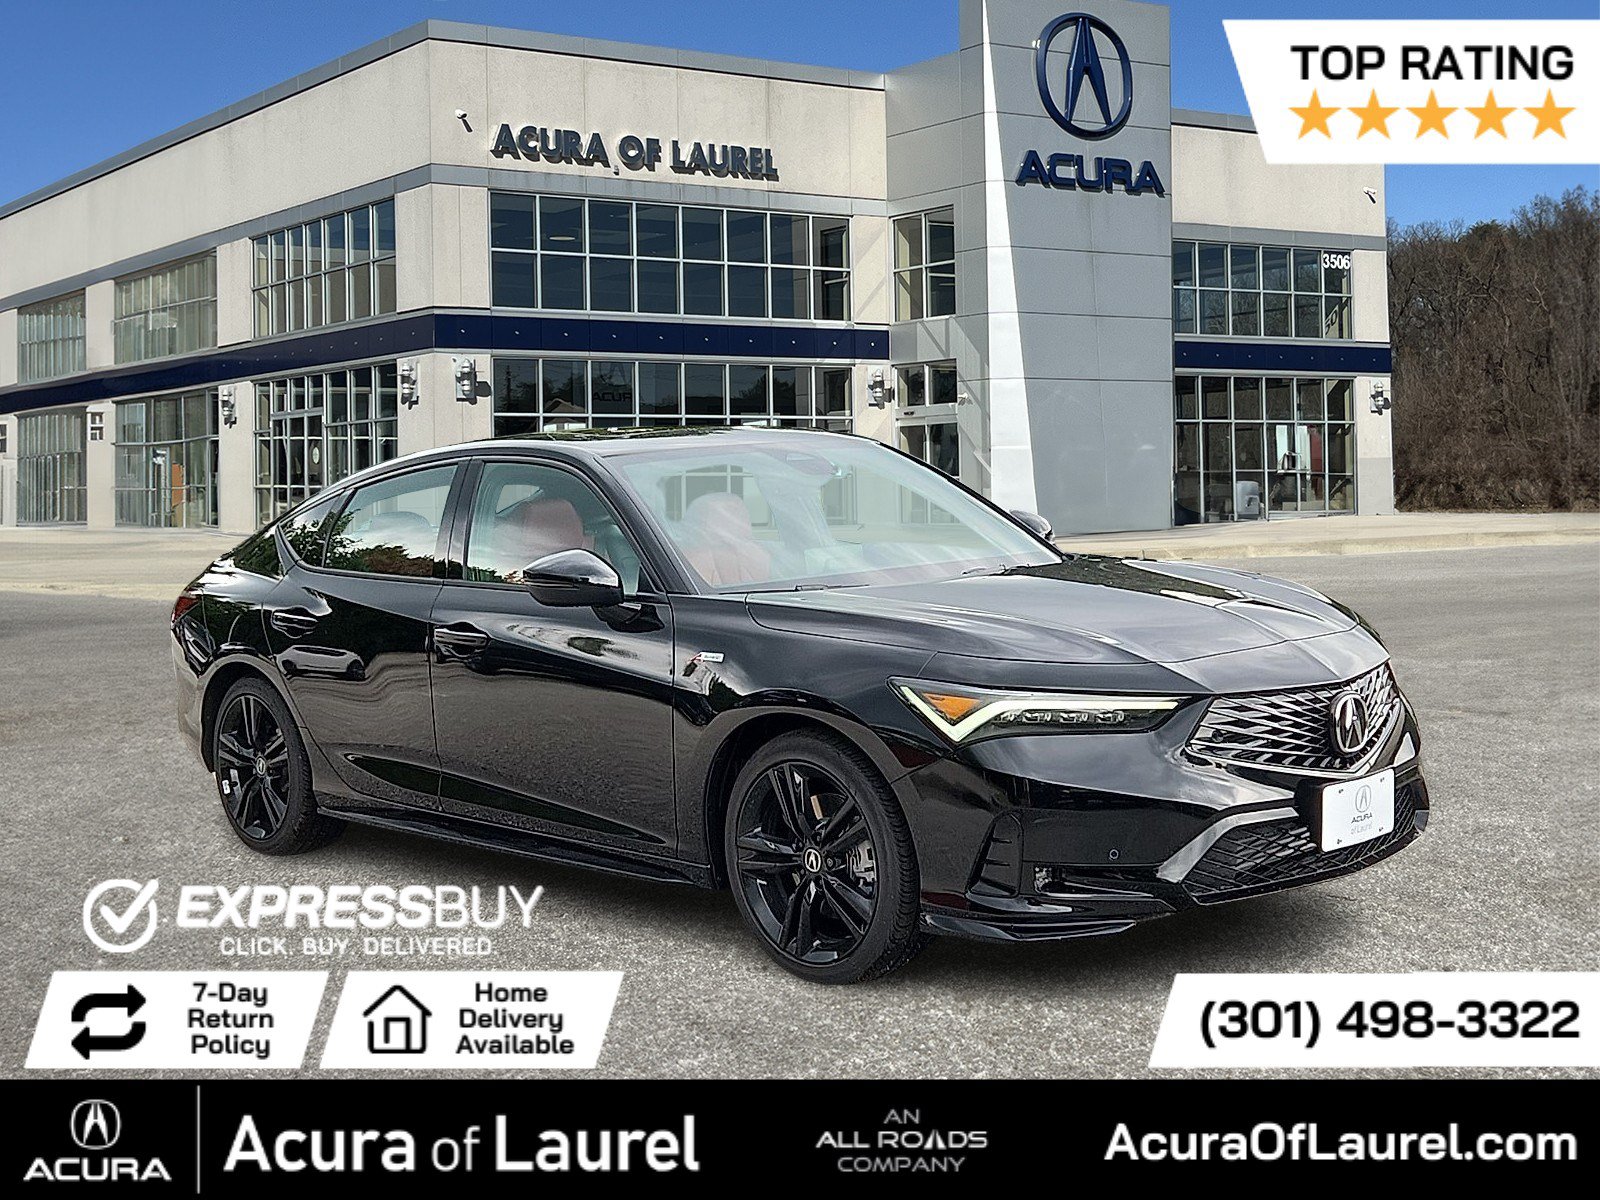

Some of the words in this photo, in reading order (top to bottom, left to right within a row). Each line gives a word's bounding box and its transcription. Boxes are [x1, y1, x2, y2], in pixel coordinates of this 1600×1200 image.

[490, 123, 611, 168] ACURA
[617, 134, 662, 172] OF
[670, 139, 779, 182] LAUREL
[1015, 149, 1166, 199] ACURA
[1322, 253, 1351, 270] 3506
